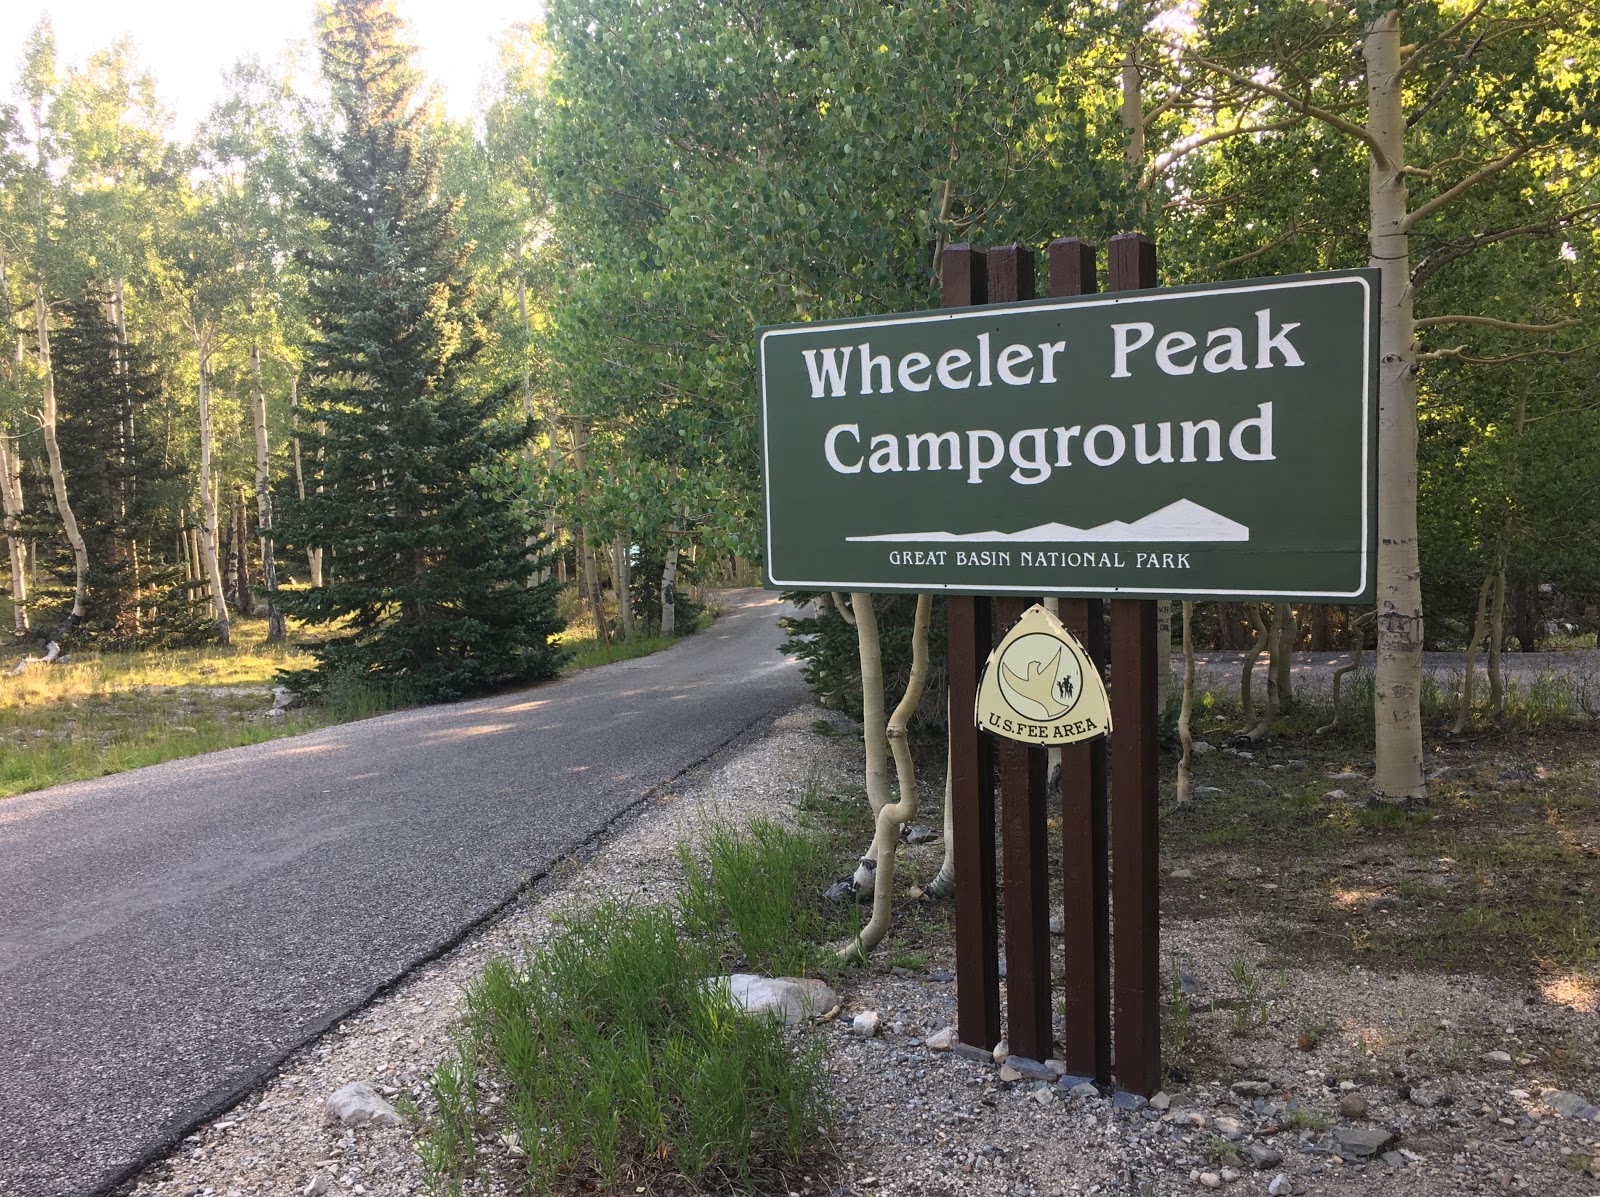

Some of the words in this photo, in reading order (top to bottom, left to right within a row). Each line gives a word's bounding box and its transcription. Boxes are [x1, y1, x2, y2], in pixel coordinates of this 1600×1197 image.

[802, 332, 1066, 398] Wheeler
[1111, 308, 1305, 378] Peak
[824, 402, 1276, 485] Campground
[889, 551, 948, 566] GREAT
[955, 551, 1011, 566] BASIN
[1020, 551, 1126, 568] NATIONAL
[1135, 552, 1191, 569] PARK
[1016, 722, 1049, 739] FEE
[1052, 717, 1098, 739] AREA
